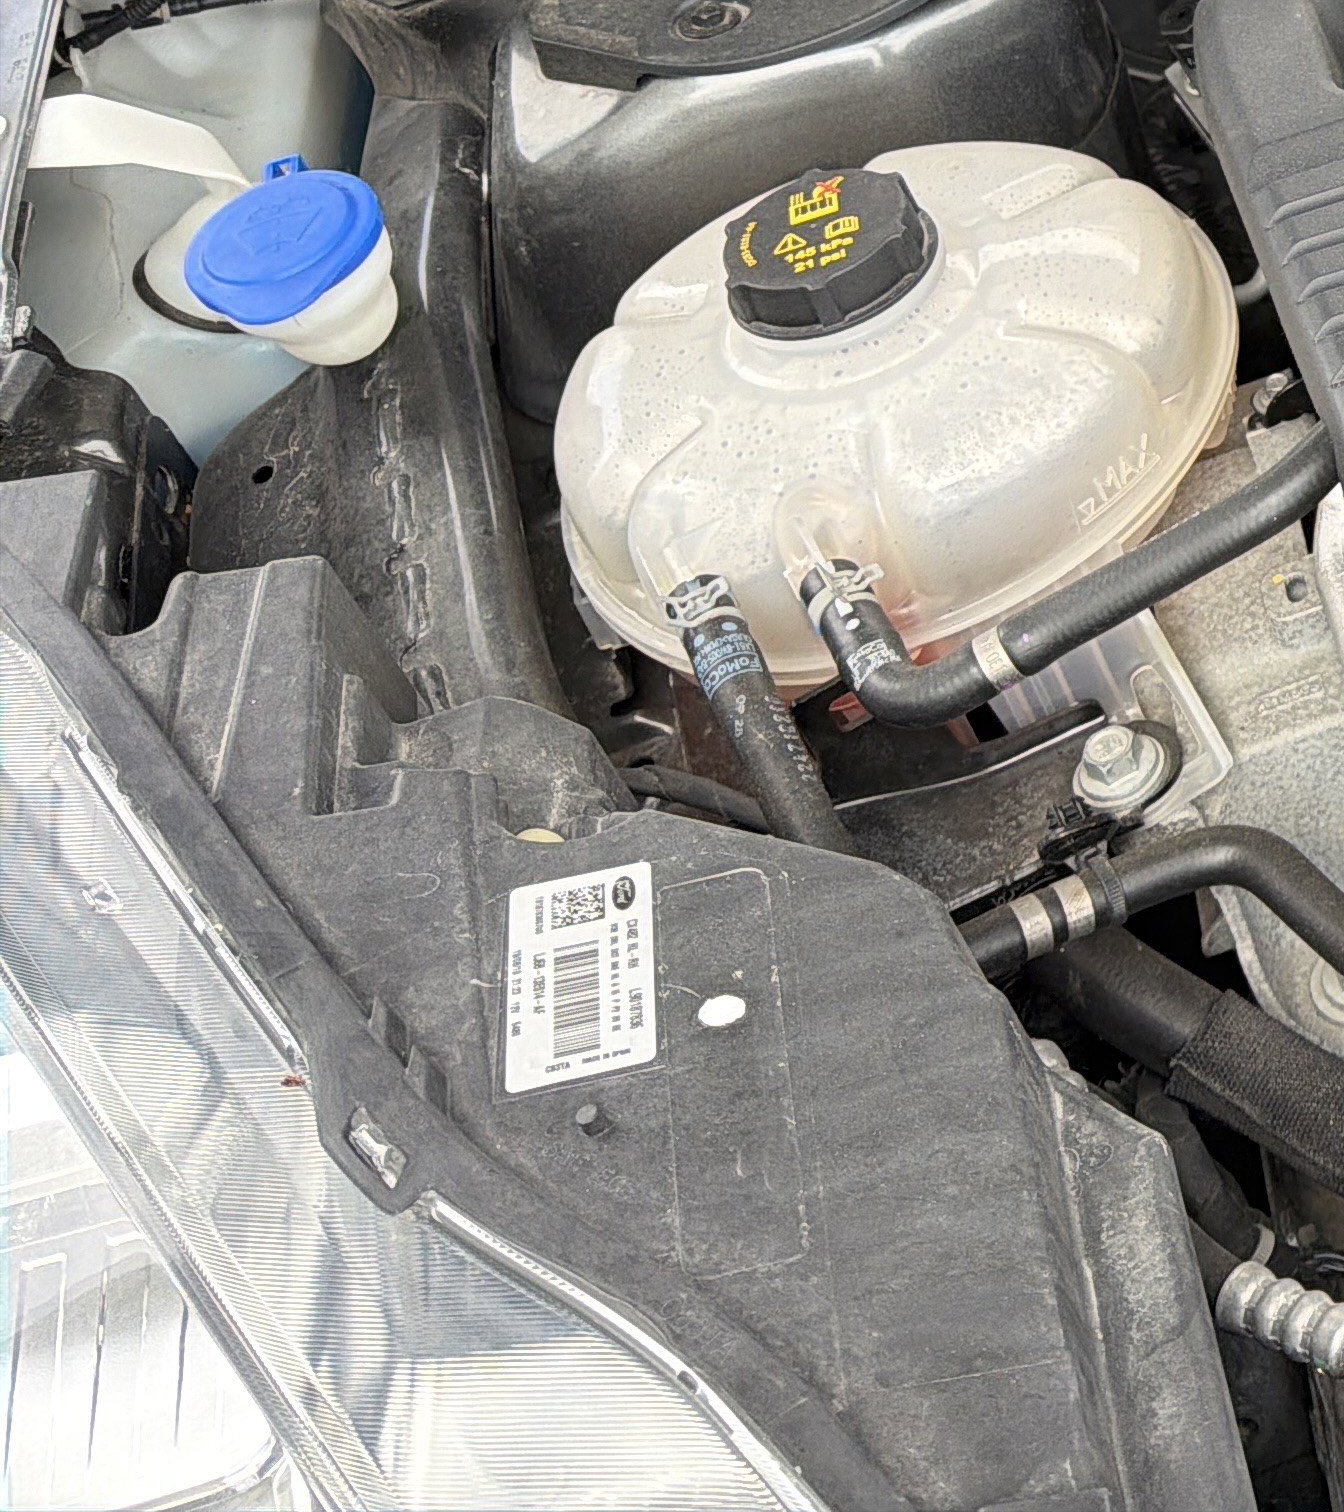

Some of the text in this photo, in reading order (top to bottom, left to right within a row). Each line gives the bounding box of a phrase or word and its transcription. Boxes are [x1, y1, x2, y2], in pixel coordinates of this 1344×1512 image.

[784, 237, 854, 263] 145 kPa
[793, 248, 847, 274] 21 psi
[1092, 432, 1157, 502] MAX
[613, 877, 634, 907] Ford
